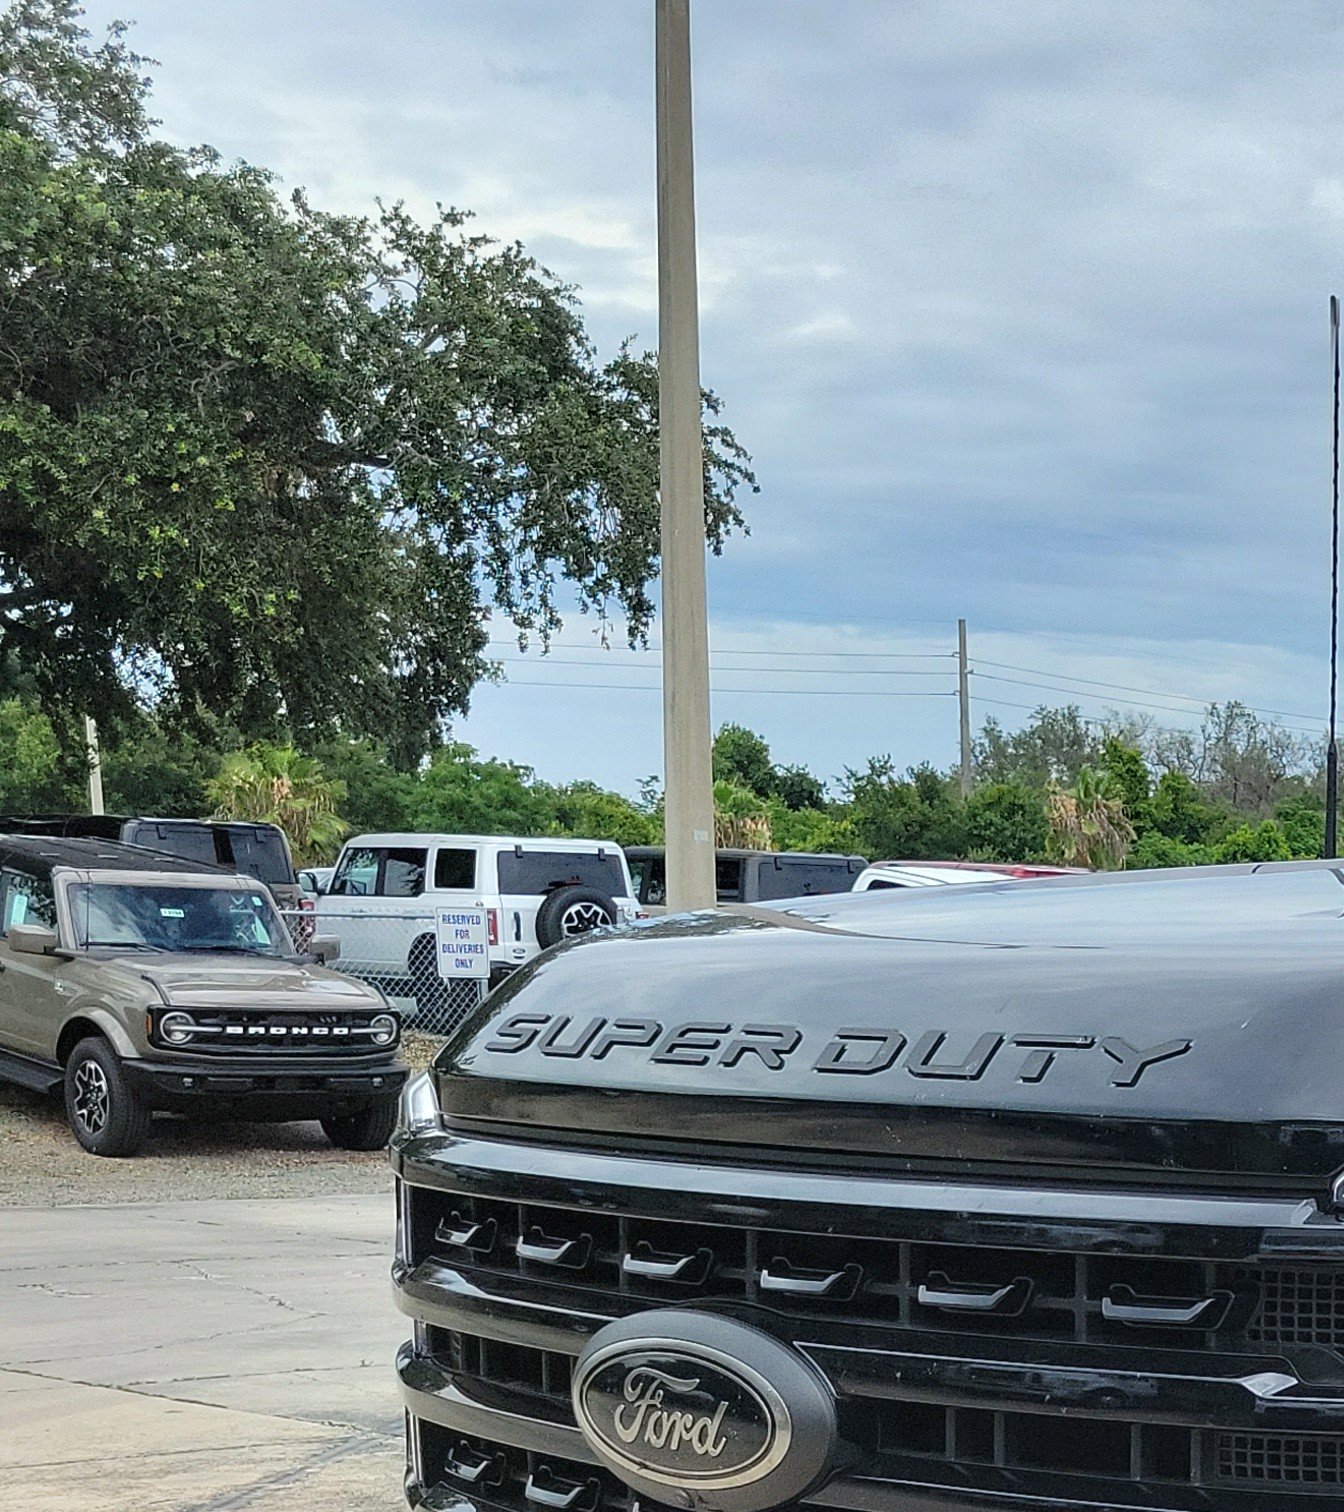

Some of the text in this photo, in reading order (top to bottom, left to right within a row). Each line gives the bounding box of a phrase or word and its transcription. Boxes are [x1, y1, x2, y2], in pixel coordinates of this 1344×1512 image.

[442, 914, 481, 925] RESERVED
[455, 928, 470, 940] FOR
[442, 943, 484, 954] DELIVERIES
[455, 958, 473, 969] ONLY
[225, 1026, 350, 1036] BRONCO
[483, 1012, 1193, 1087] SUPER DUTY
[614, 1366, 730, 1458] Ford
